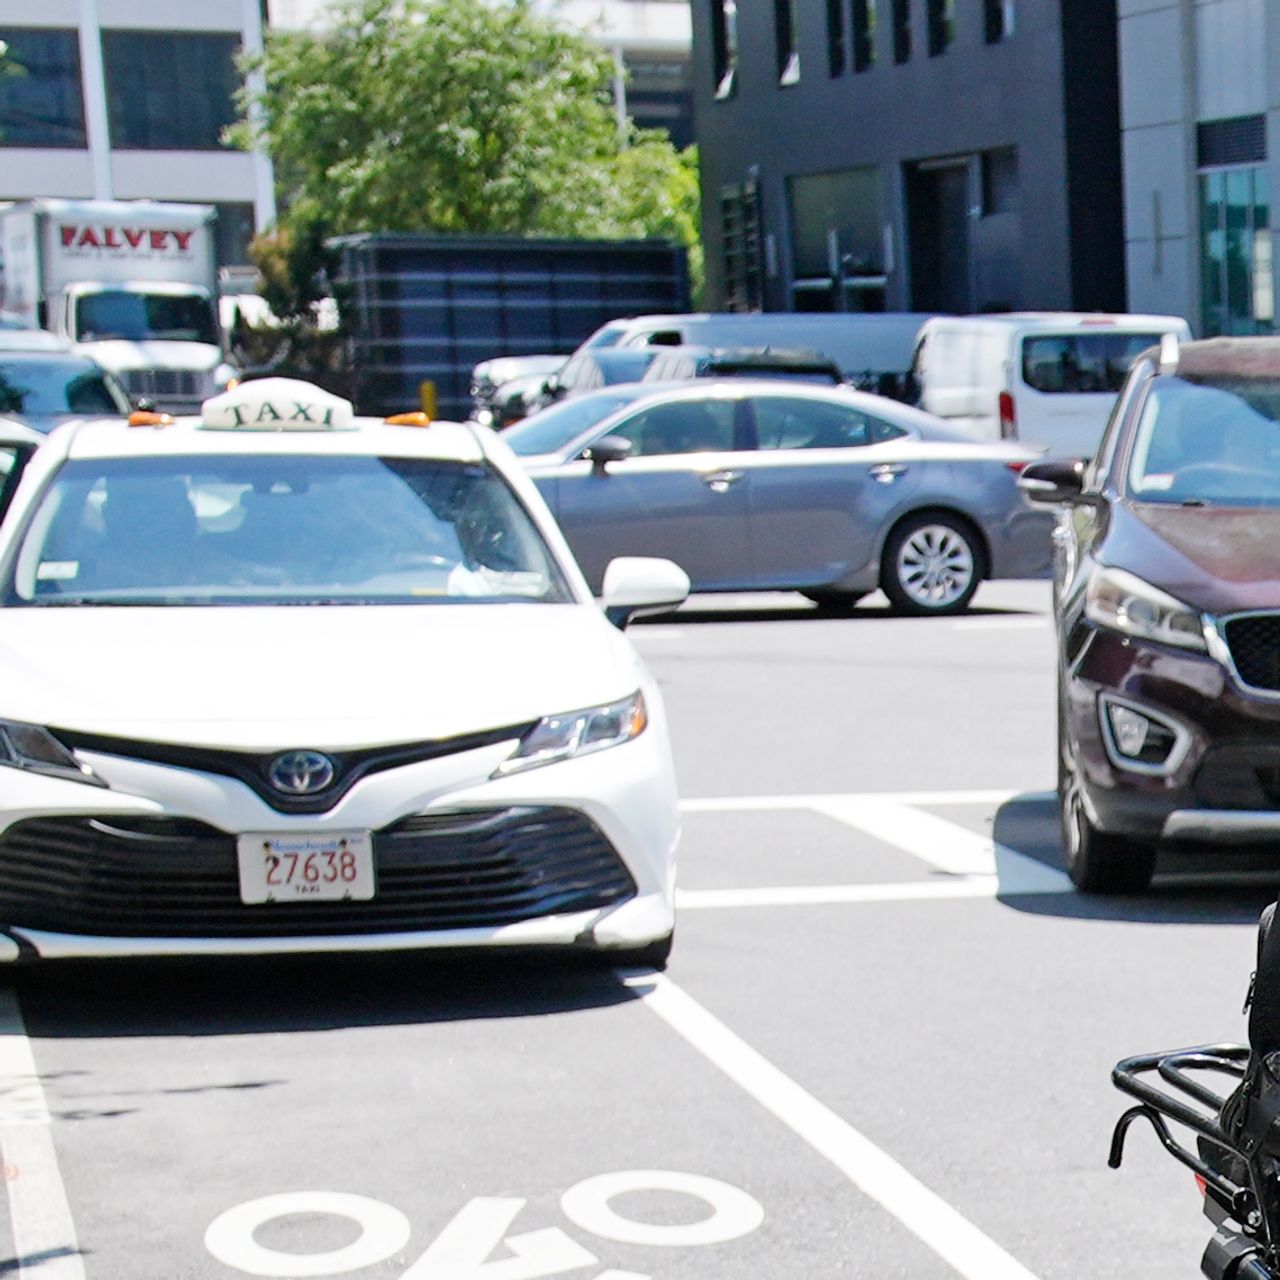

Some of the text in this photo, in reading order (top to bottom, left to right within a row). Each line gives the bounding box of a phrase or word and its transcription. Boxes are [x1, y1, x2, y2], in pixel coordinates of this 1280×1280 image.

[61, 225, 193, 250] FALVEY
[224, 400, 334, 428] TAXI
[265, 851, 356, 885] 27638
